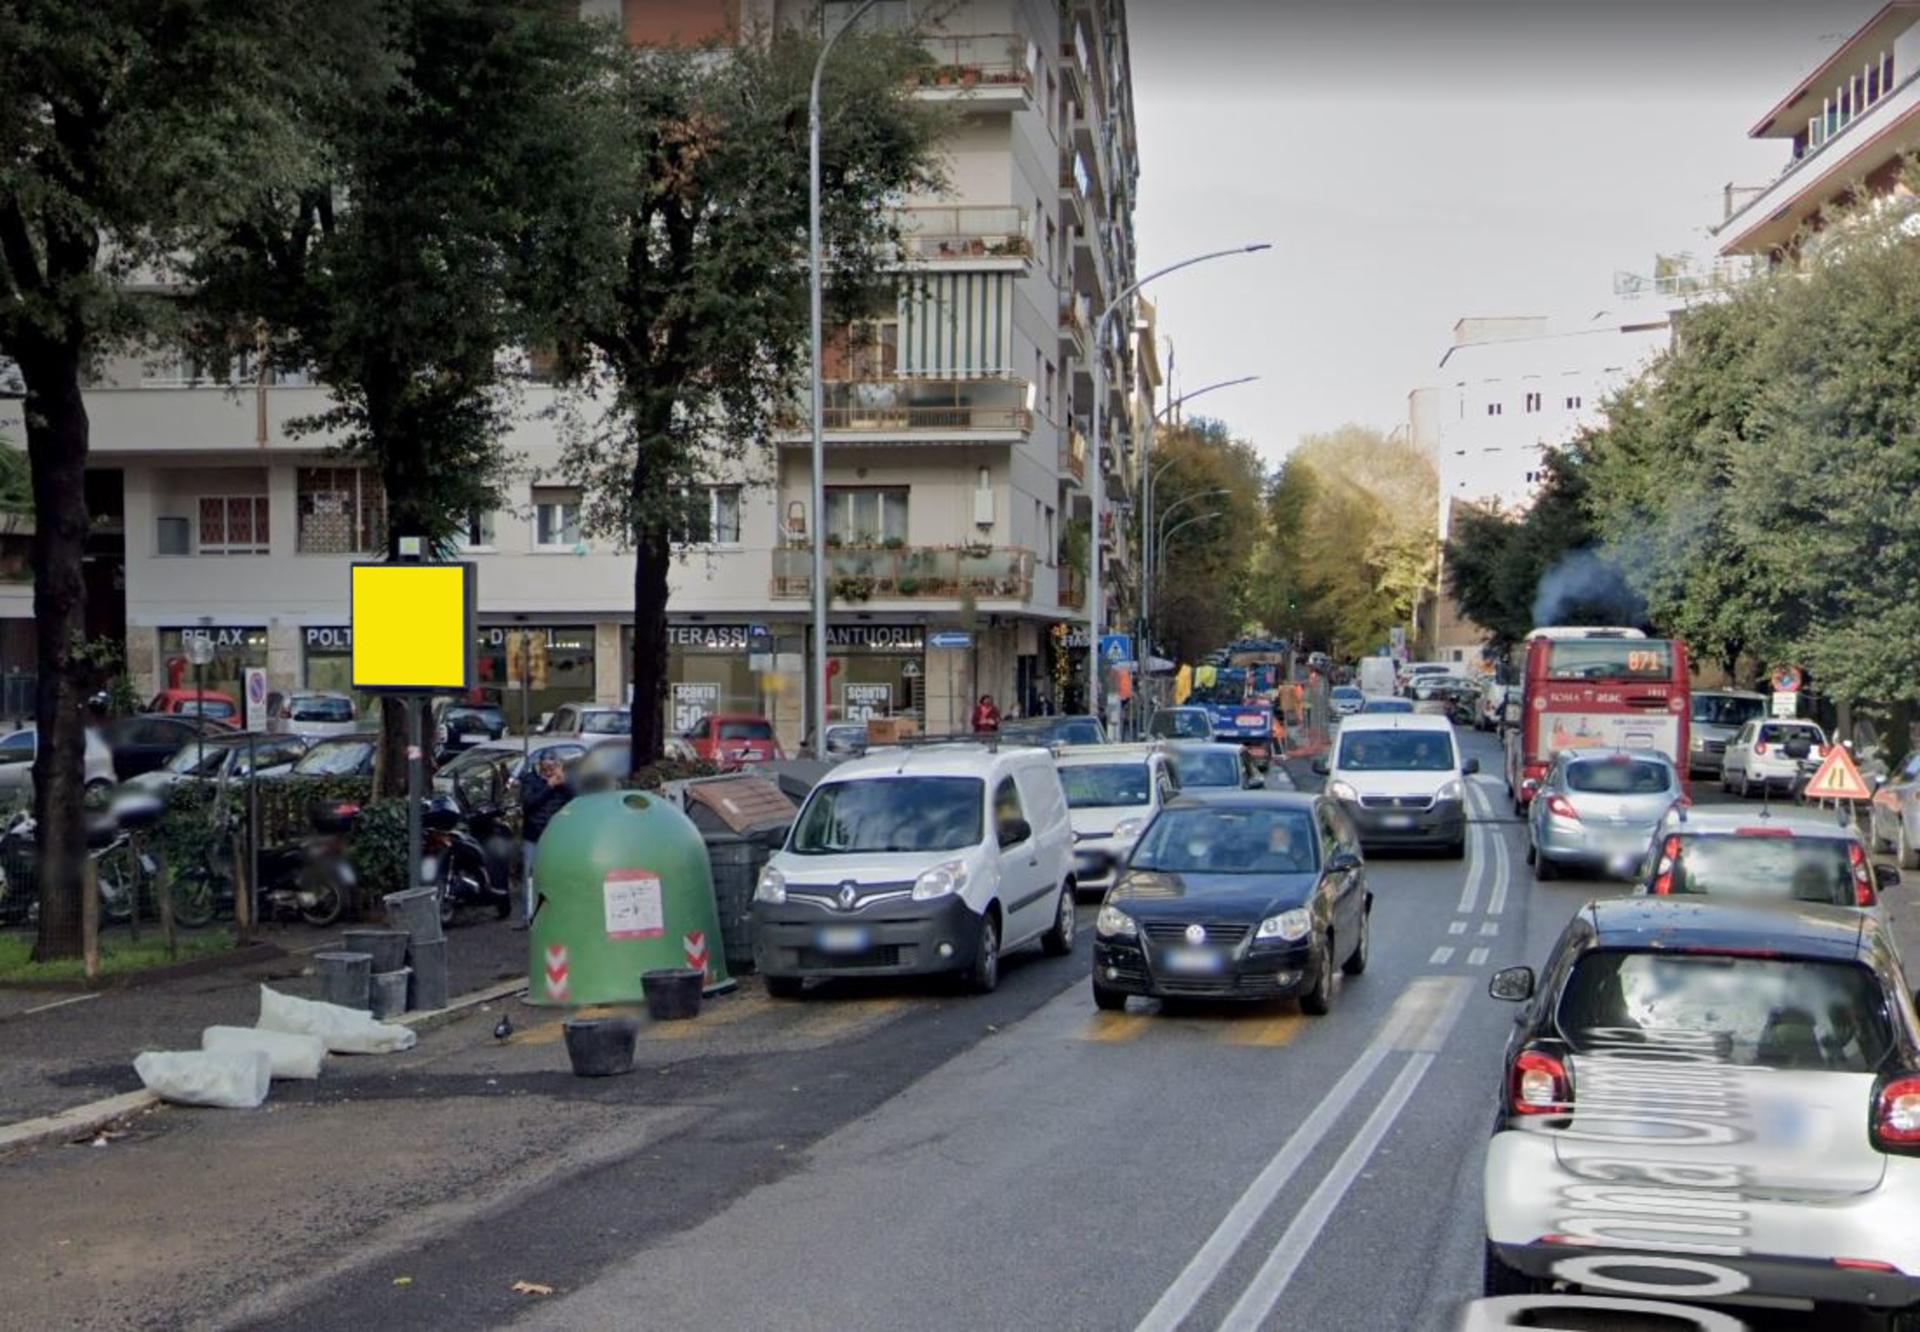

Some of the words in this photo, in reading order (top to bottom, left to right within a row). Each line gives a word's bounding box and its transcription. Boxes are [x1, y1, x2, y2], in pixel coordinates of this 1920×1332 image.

[307, 628, 352, 646] POLT
[667, 627, 748, 645] TERASSI
[825, 627, 911, 645] ANTUORI
